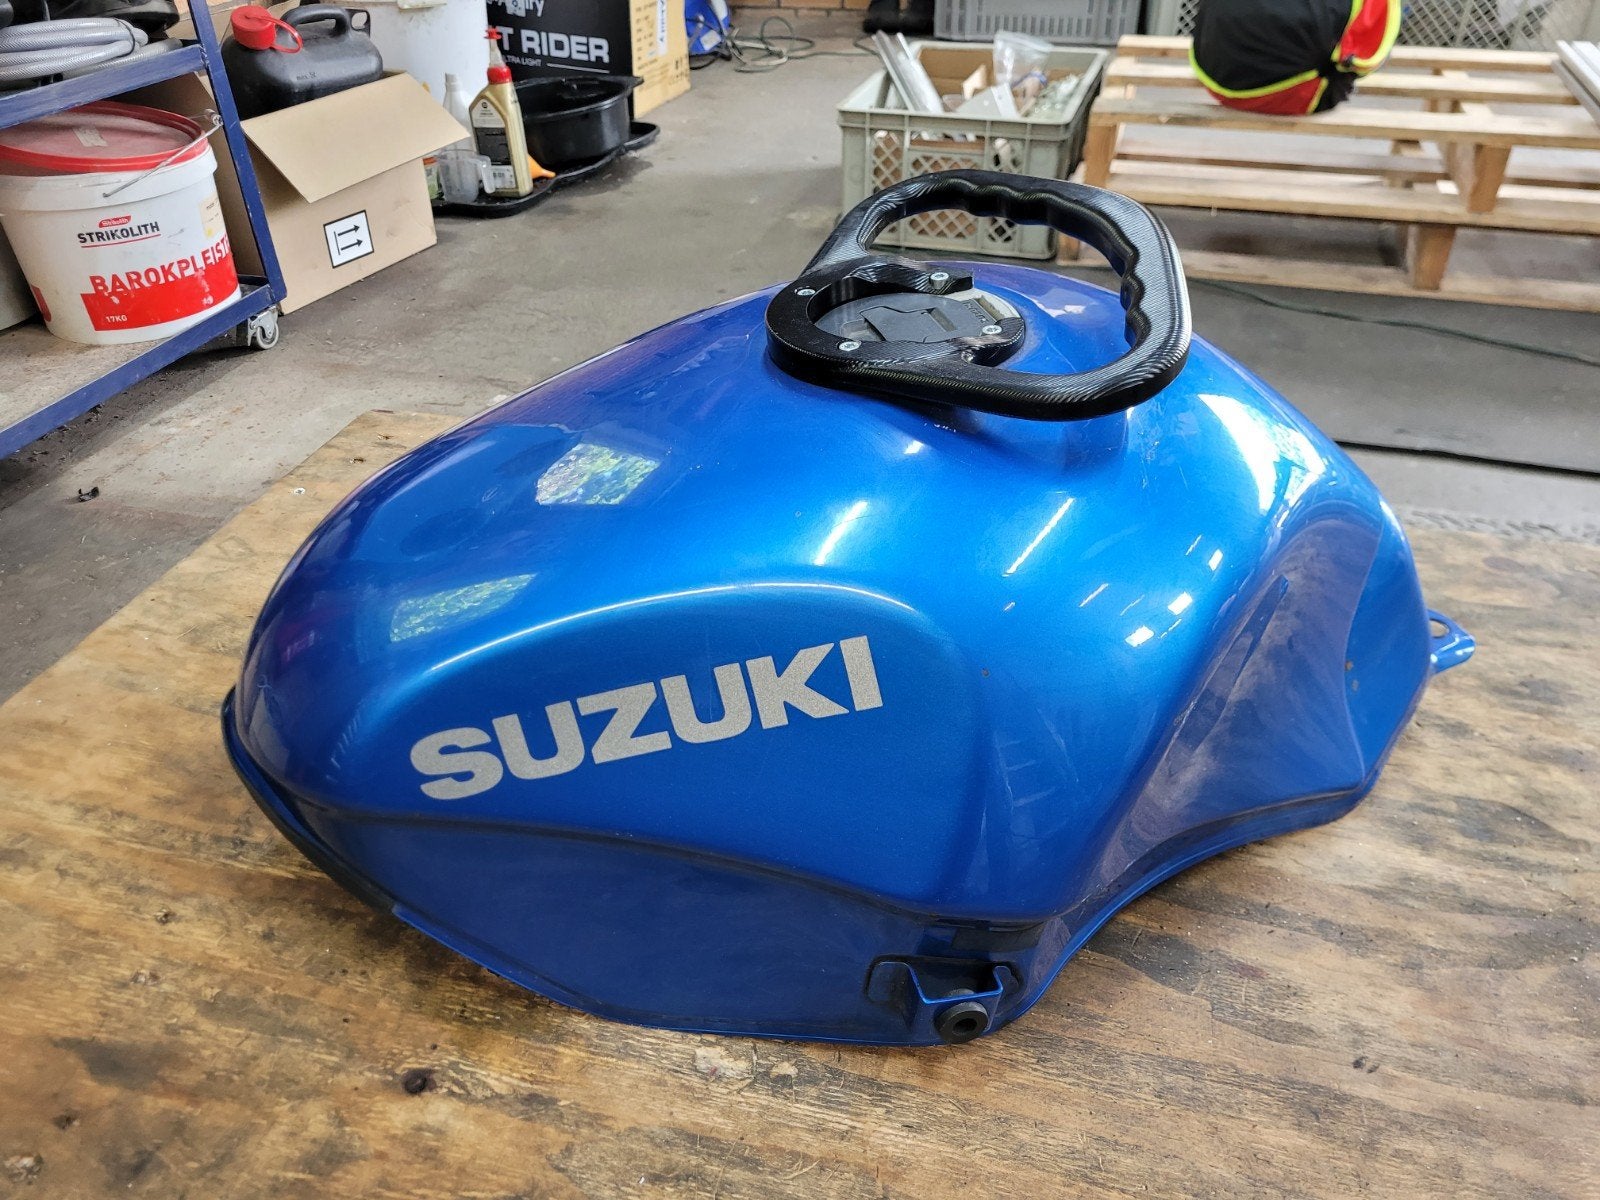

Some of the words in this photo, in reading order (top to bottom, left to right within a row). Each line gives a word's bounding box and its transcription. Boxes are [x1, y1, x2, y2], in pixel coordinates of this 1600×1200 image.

[520, 28, 610, 64] RIDER
[77, 221, 160, 244] STRIKOLITH
[105, 314, 128, 323] 17KG
[409, 635, 884, 800] SUZUKI
